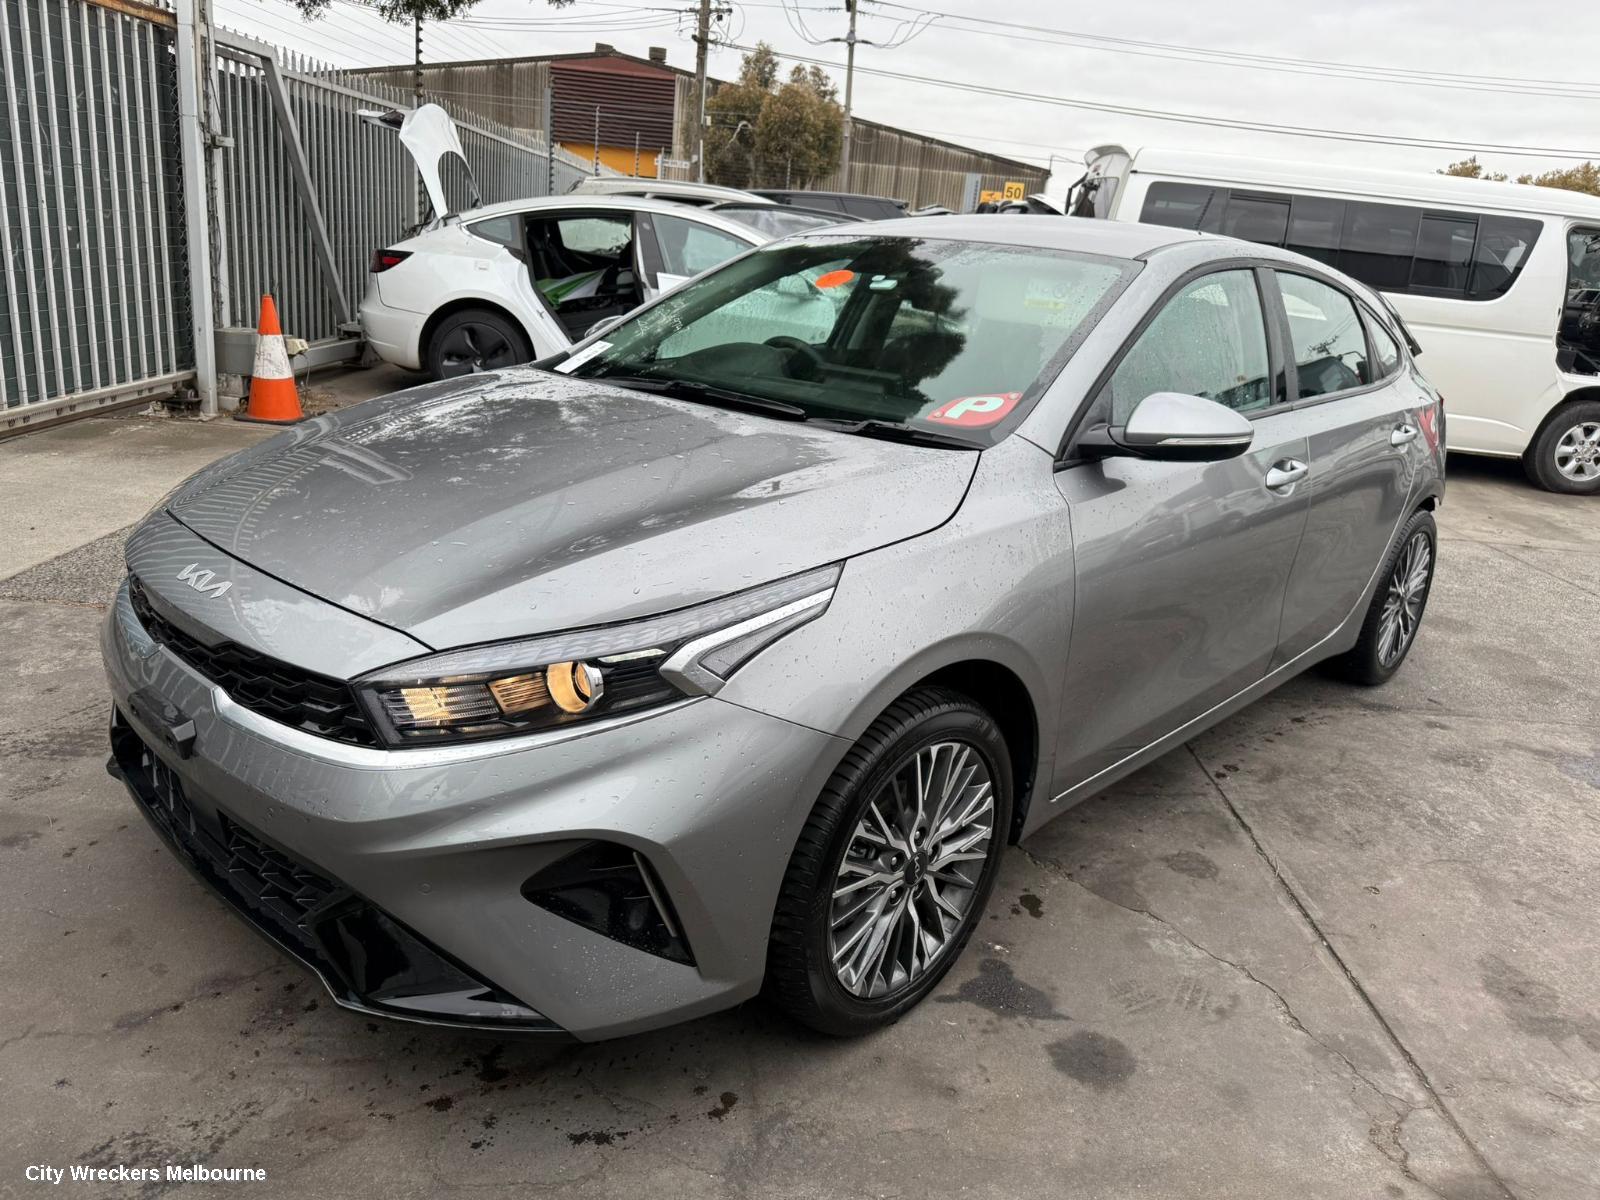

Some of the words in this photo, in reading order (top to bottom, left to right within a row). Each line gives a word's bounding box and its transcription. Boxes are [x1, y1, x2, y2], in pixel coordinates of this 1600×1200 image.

[1005, 187, 1022, 199] 50
[944, 397, 1004, 419] P
[176, 562, 233, 598] KIA
